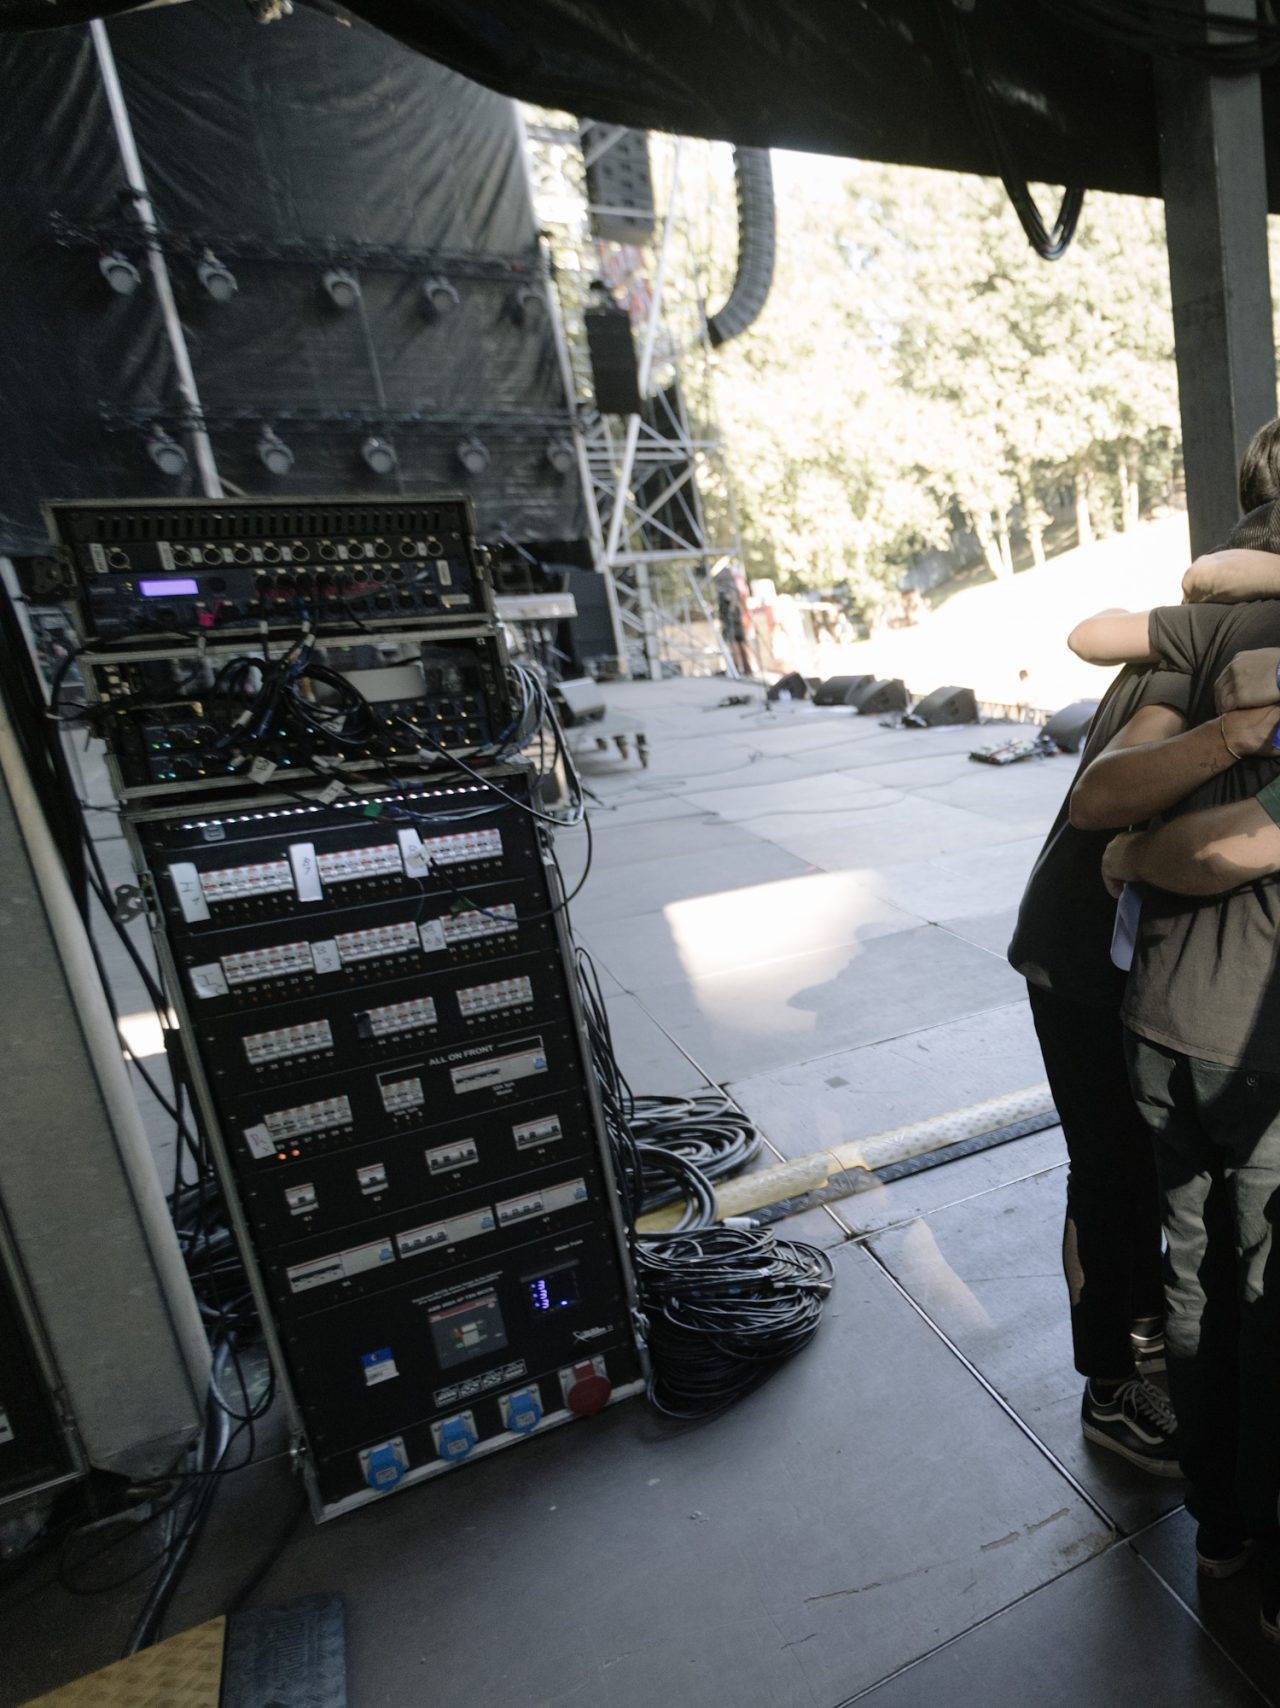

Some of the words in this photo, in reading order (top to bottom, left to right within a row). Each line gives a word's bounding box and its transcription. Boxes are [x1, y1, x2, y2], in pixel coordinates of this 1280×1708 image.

[428, 1057, 445, 1067] ALL
[448, 1053, 463, 1062] ON
[463, 1044, 494, 1059] FRONT
